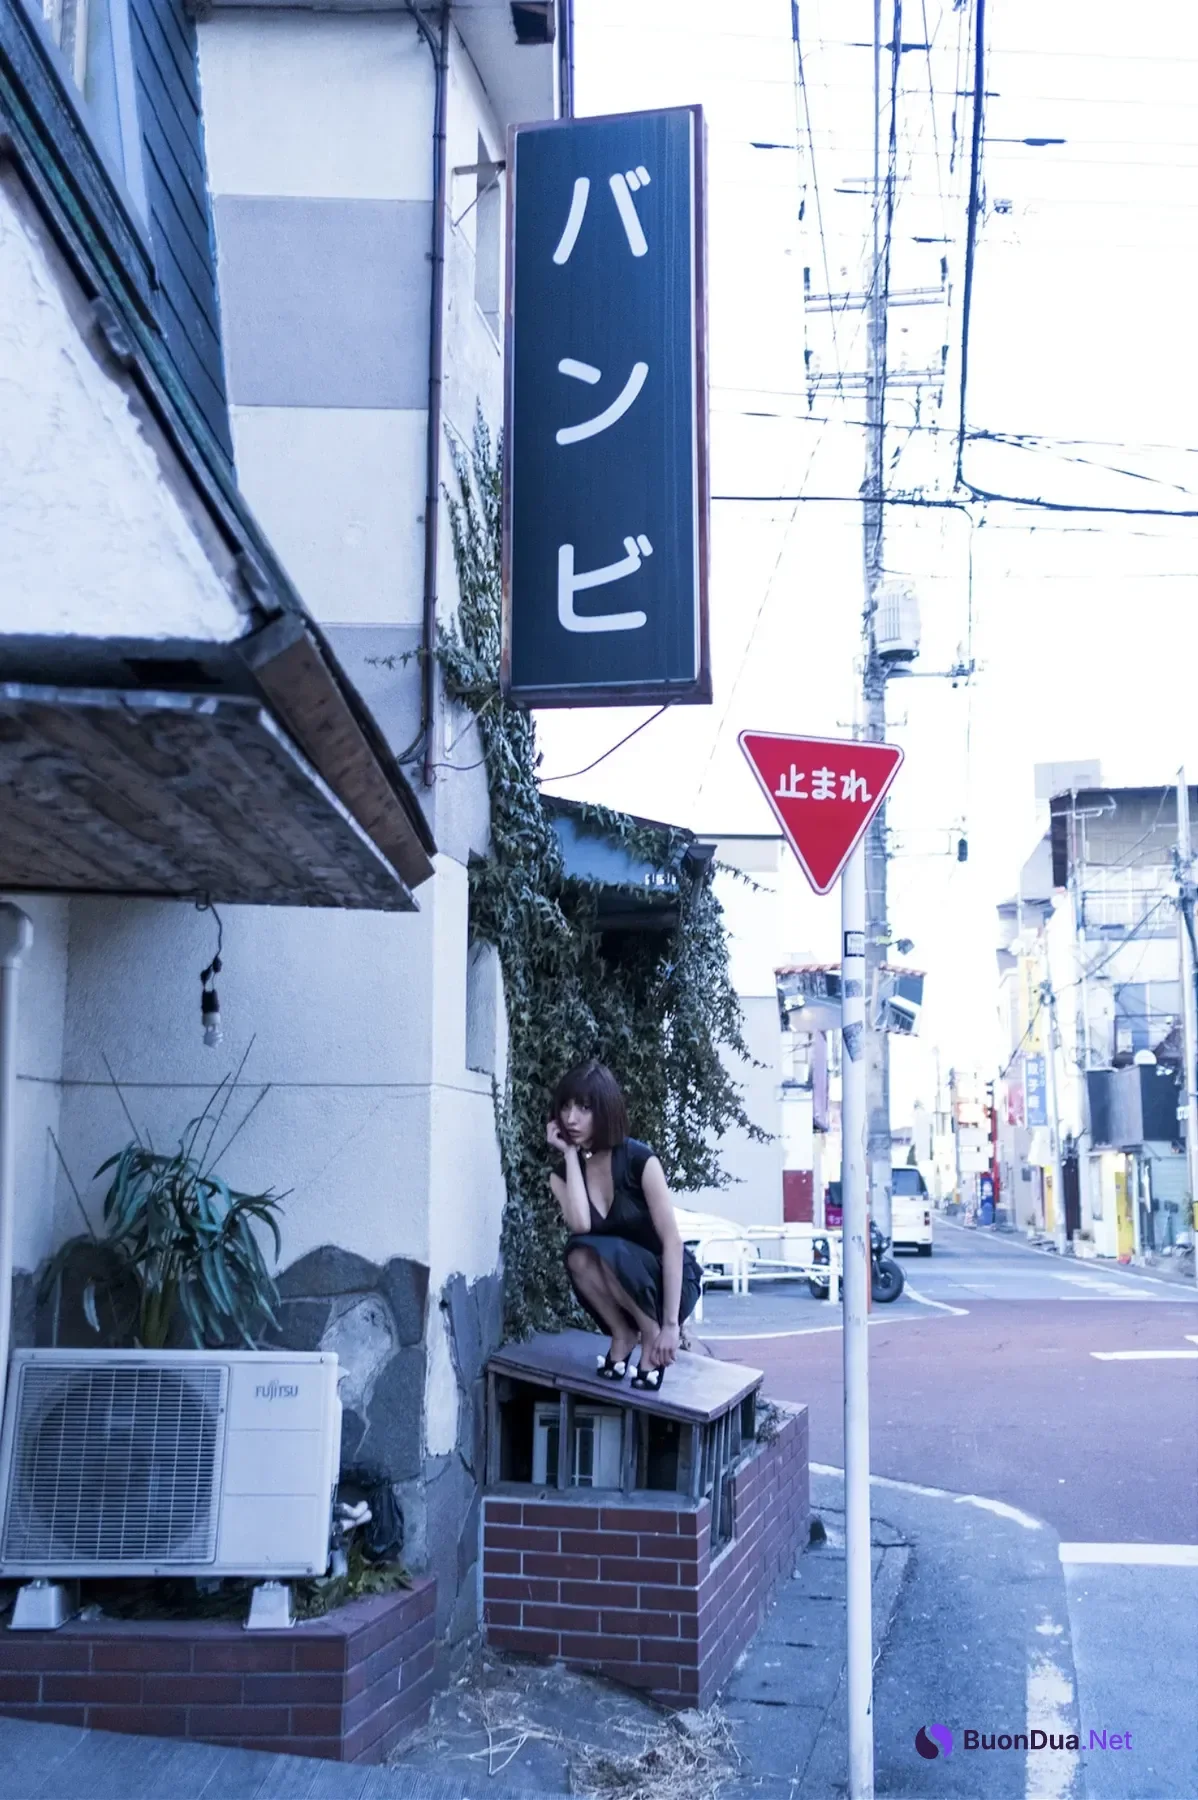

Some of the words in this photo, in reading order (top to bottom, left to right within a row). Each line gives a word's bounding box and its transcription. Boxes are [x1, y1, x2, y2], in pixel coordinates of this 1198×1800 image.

[552, 165, 654, 633] バンビ
[774, 763, 873, 803] 止まれ
[255, 1379, 299, 1402] FUJITSU
